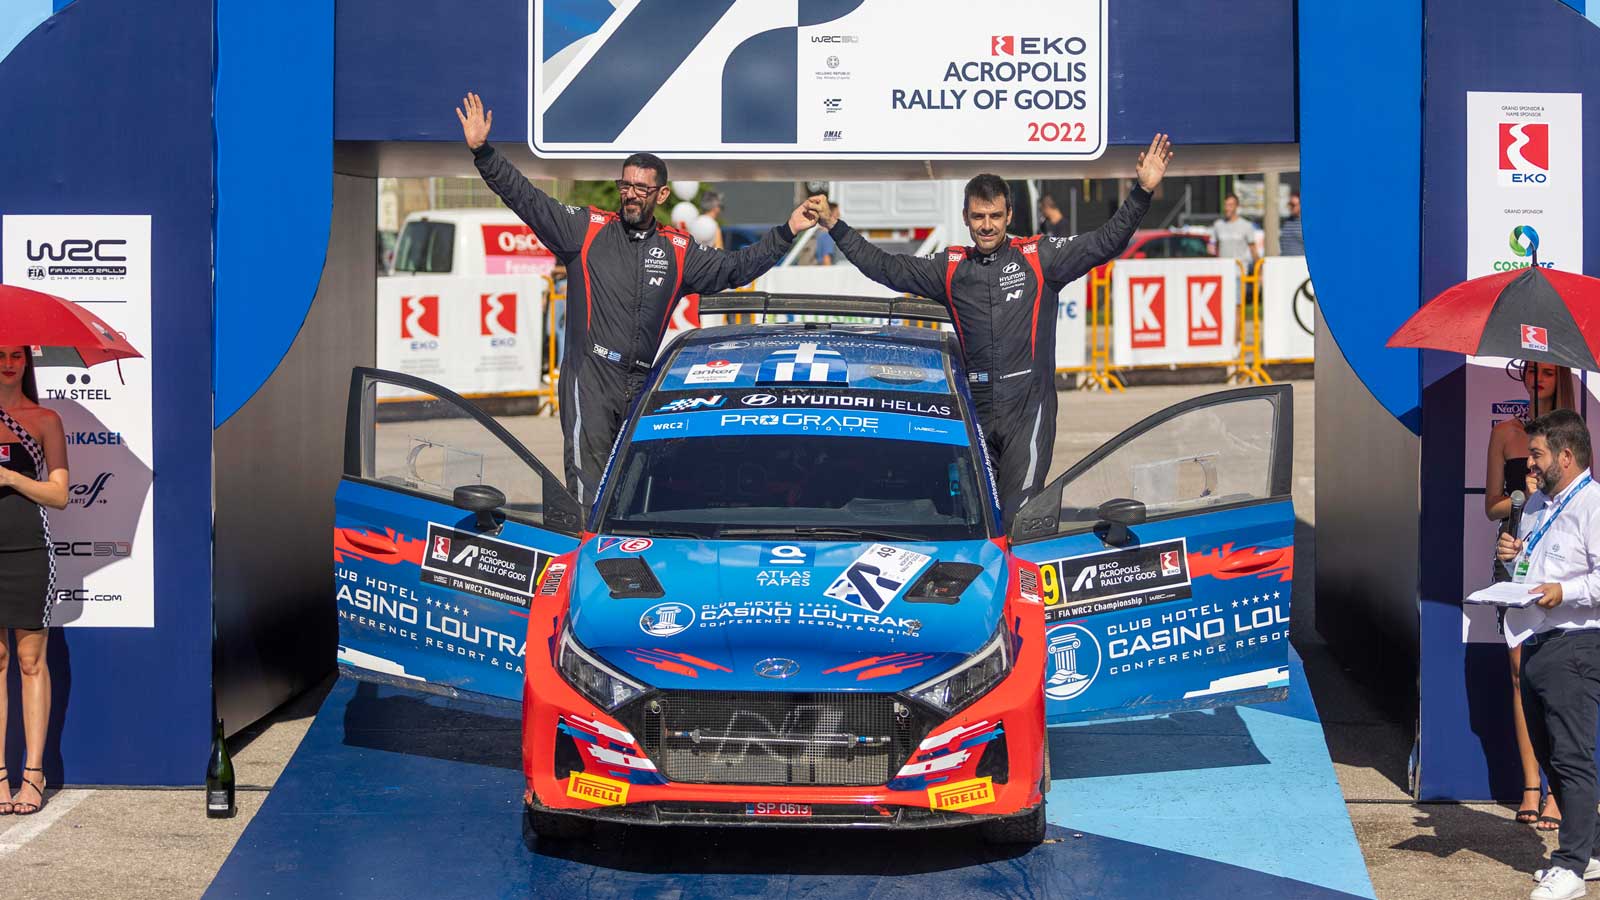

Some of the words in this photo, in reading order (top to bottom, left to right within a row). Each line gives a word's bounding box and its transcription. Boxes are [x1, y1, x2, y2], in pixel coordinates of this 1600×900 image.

[1021, 36, 1087, 55] EKO
[943, 62, 1087, 83] ACROPOLIS
[892, 89, 967, 110] RALLY
[973, 89, 1008, 110] OF
[1014, 89, 1087, 110] GODS
[1027, 122, 1087, 142] 2022
[1511, 173, 1547, 183] EKO
[27, 239, 126, 261] WRC
[1132, 282, 1162, 331] K
[1190, 282, 1218, 329] K
[46, 389, 66, 400] TW
[70, 389, 111, 400] STEEL
[782, 394, 874, 407] HYUNDAI
[881, 399, 950, 415] HELLAS
[653, 422, 683, 430] WRC2
[51, 542, 131, 556] RC50
[480, 547, 498, 557] EKO
[478, 564, 497, 576] RALLY
[508, 572, 526, 582] GODS
[480, 556, 515, 569] ACROPOLIS
[1099, 562, 1119, 570] EKO
[1100, 565, 1141, 578] ACROPOLIS
[366, 577, 418, 602] HOTEL
[1040, 564, 1059, 605] 9
[1101, 577, 1122, 587] RALLY
[1123, 575, 1134, 583] OF
[1135, 571, 1157, 581] GODS
[453, 580, 464, 588] FIA
[464, 582, 482, 593] WRC2
[483, 587, 526, 605] Championship
[336, 585, 418, 624] ASINO
[702, 602, 736, 610] CLUB
[1058, 610, 1070, 618] FIA
[1071, 606, 1092, 615] WRC2
[1094, 597, 1142, 612] Championship
[700, 619, 790, 628] CONFERENCE
[798, 620, 851, 630] RESORT
[701, 608, 792, 620] CASINO
[799, 608, 914, 628] LOUTRAK
[1107, 618, 1151, 636] CLUB
[1161, 603, 1223, 624] HOTEL
[339, 610, 417, 640] NFERENCE
[425, 637, 485, 661] RESORT
[491, 657, 499, 665] &
[1109, 618, 1224, 659] CASINO
[1110, 643, 1226, 675] CONFERENCE
[573, 777, 622, 802] PIRELLI
[935, 783, 988, 808] PIRELLI
[757, 802, 776, 814] SP
[780, 803, 809, 814] 0613
